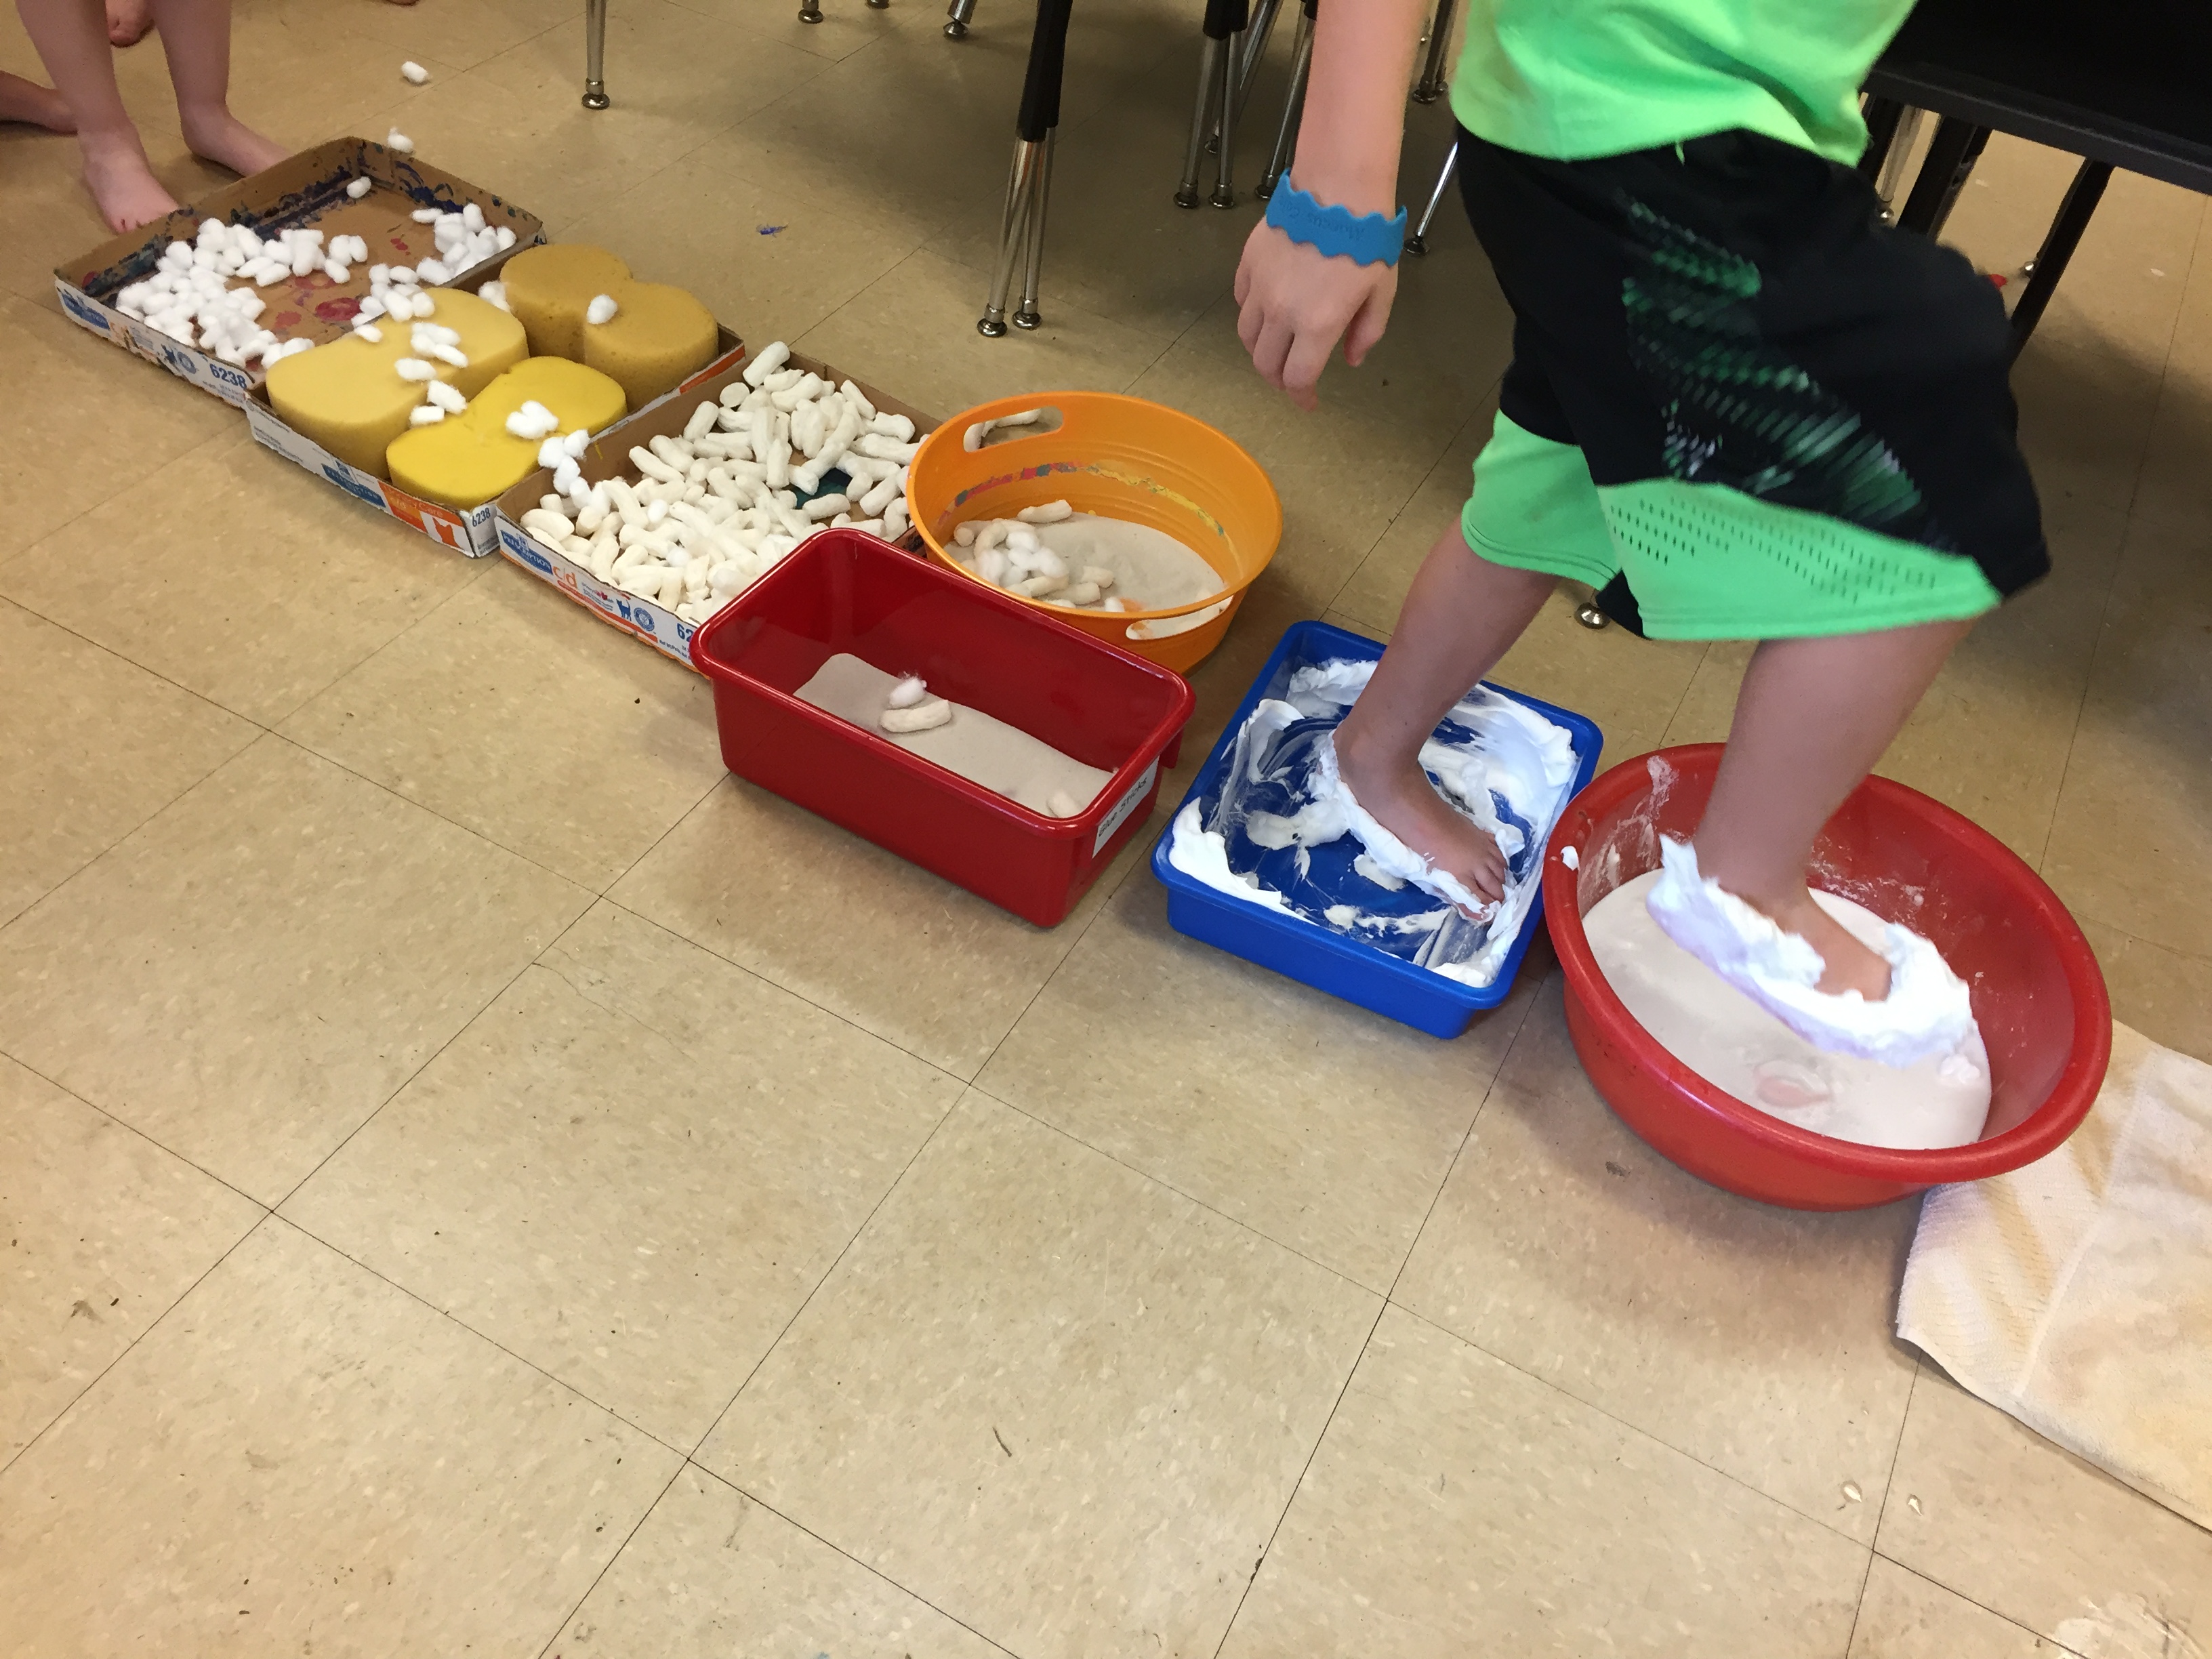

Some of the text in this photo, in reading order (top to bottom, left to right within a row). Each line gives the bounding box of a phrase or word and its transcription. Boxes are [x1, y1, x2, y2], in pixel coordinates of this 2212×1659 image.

[209, 363, 247, 390] 6238
[472, 507, 491, 527] 6238
[553, 566, 577, 589] c/d
[677, 622, 693, 642] 62
[1120, 777, 1147, 813] Sticks
